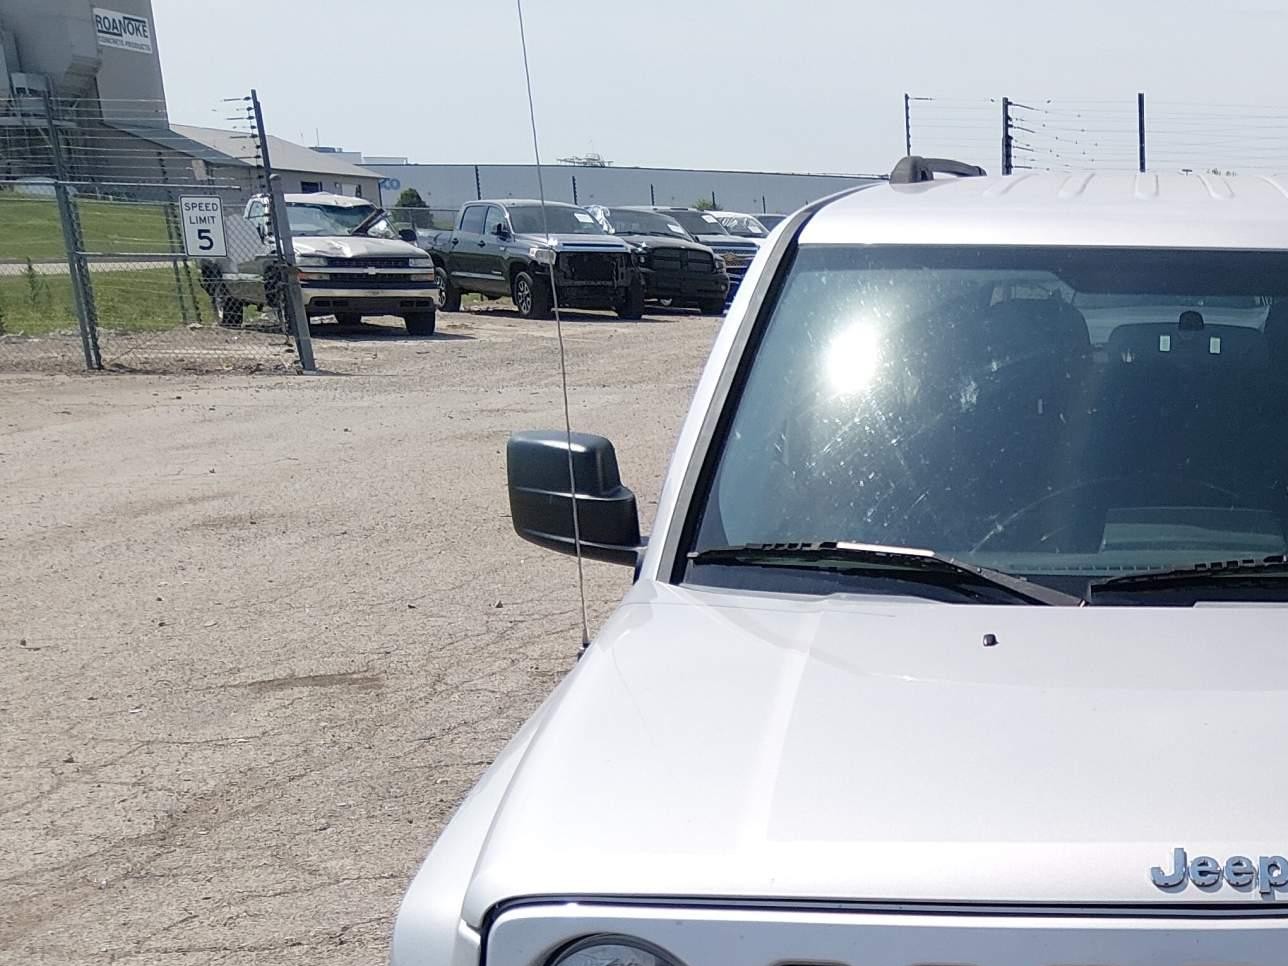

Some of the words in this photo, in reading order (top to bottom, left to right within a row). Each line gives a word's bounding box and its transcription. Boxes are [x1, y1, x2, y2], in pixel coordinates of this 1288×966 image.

[95, 14, 148, 38] ROANOKE
[184, 202, 219, 211] SPEED
[189, 215, 216, 225] LIMIT
[197, 229, 214, 251] 5
